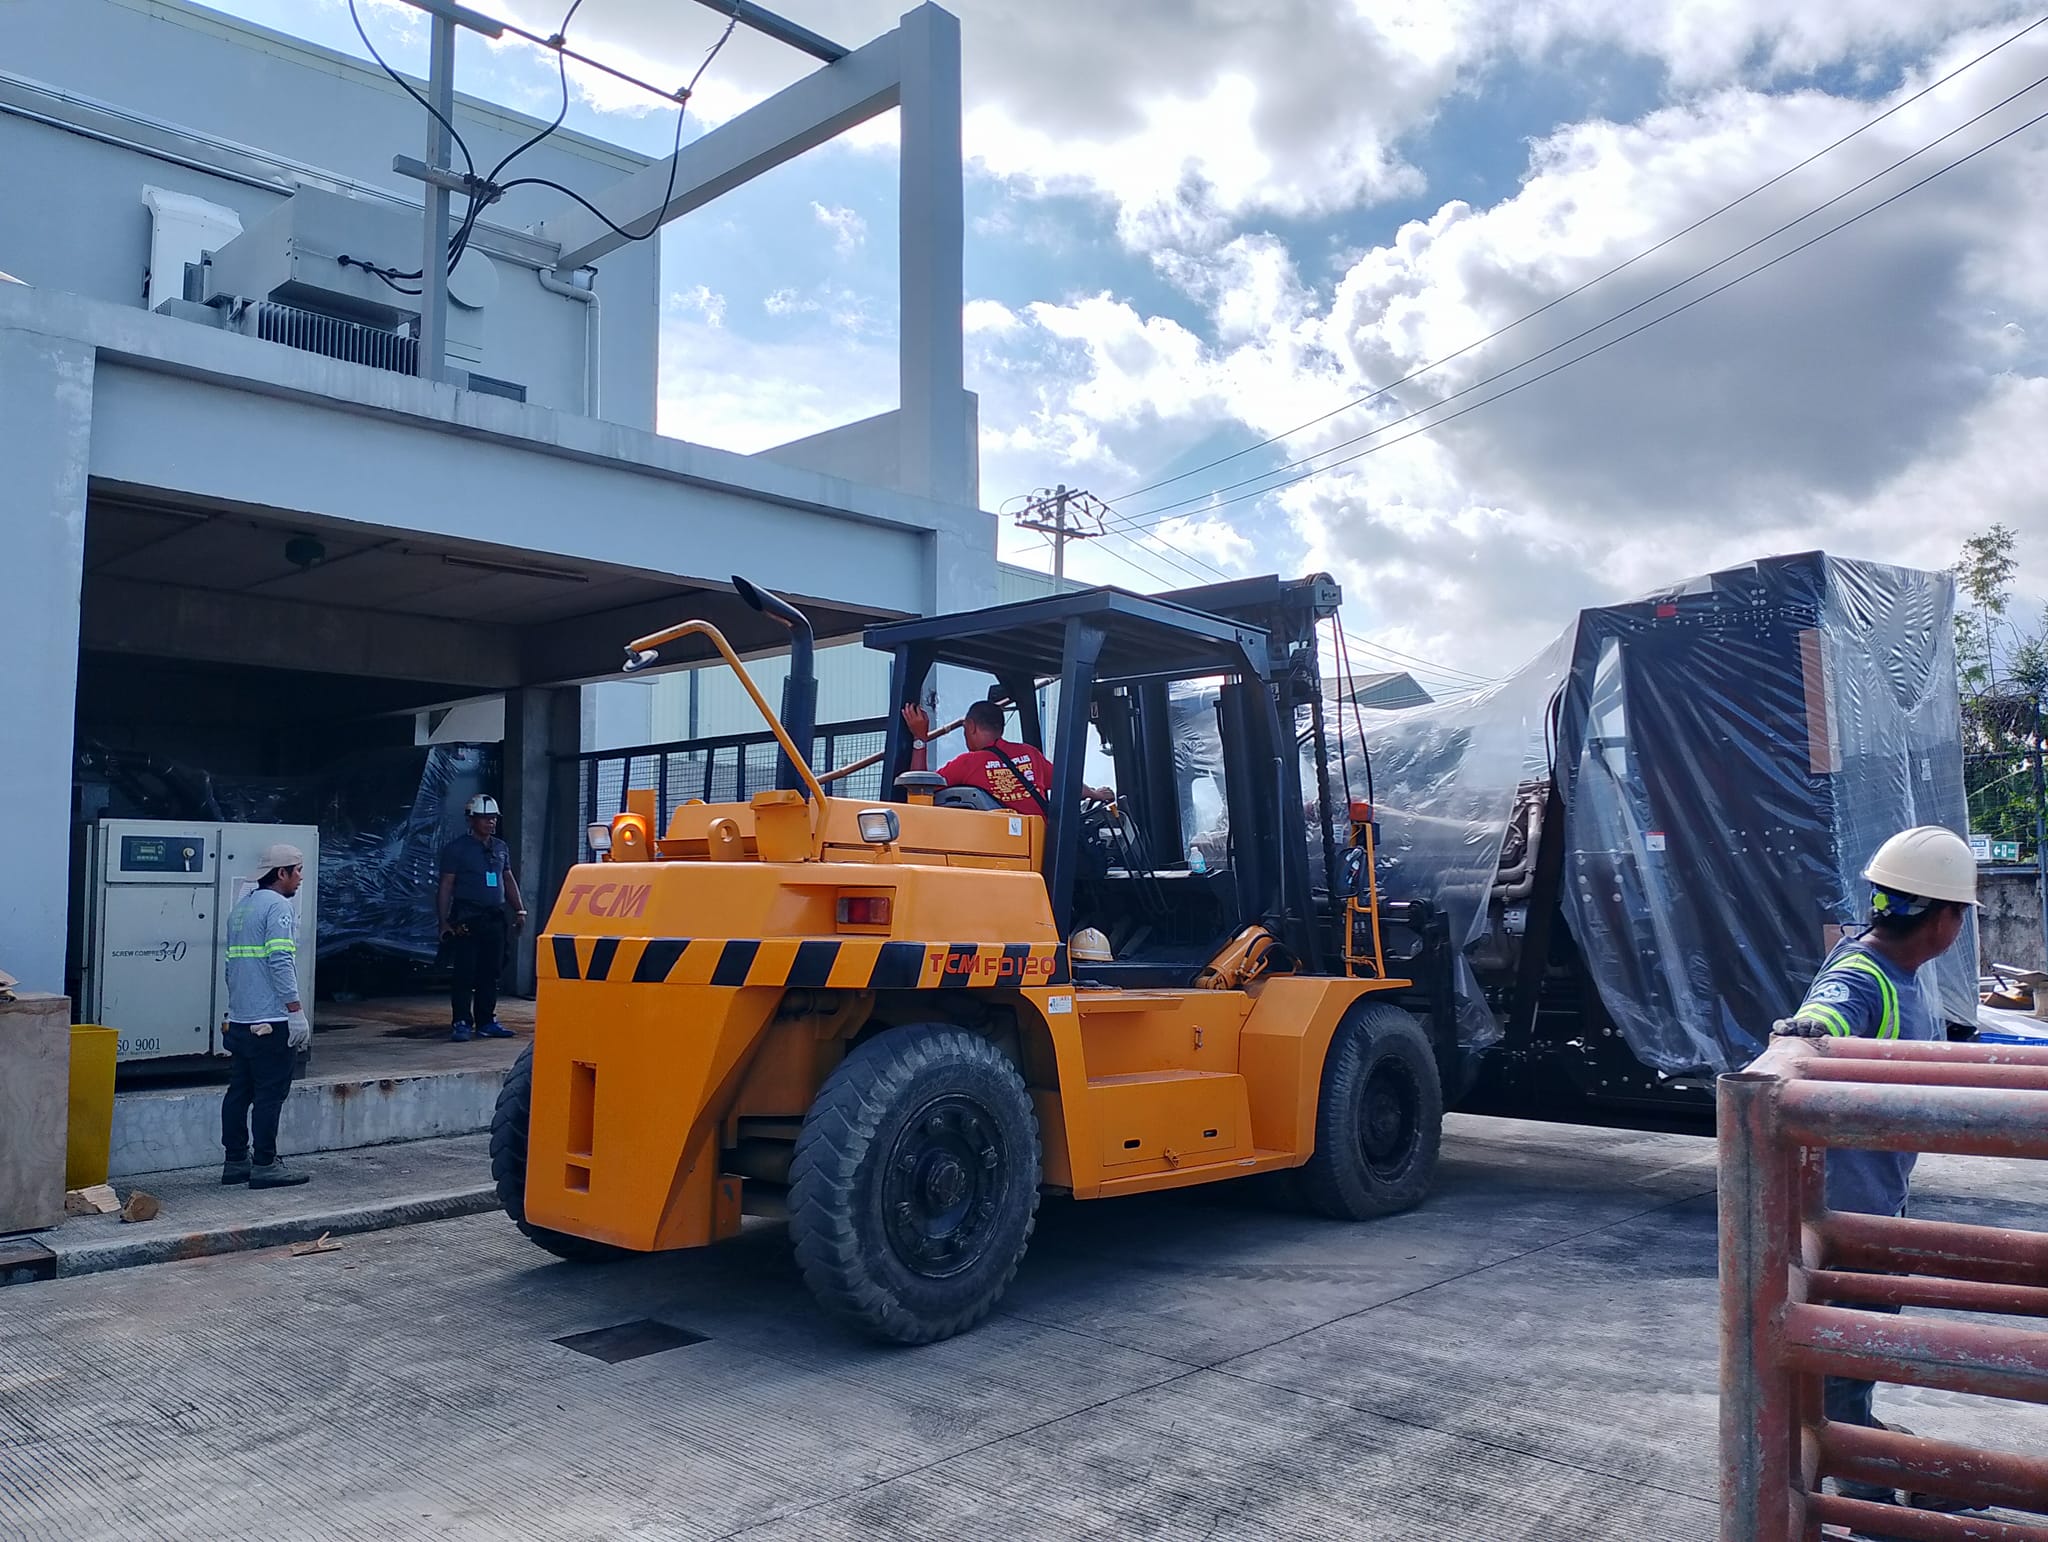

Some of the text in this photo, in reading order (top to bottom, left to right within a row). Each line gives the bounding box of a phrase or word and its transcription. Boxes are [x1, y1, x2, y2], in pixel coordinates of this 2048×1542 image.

[565, 883, 652, 918] TCM
[111, 950, 134, 958] SCREW
[929, 953, 1057, 976] TCM FD120
[117, 1037, 160, 1052] SO 9001
